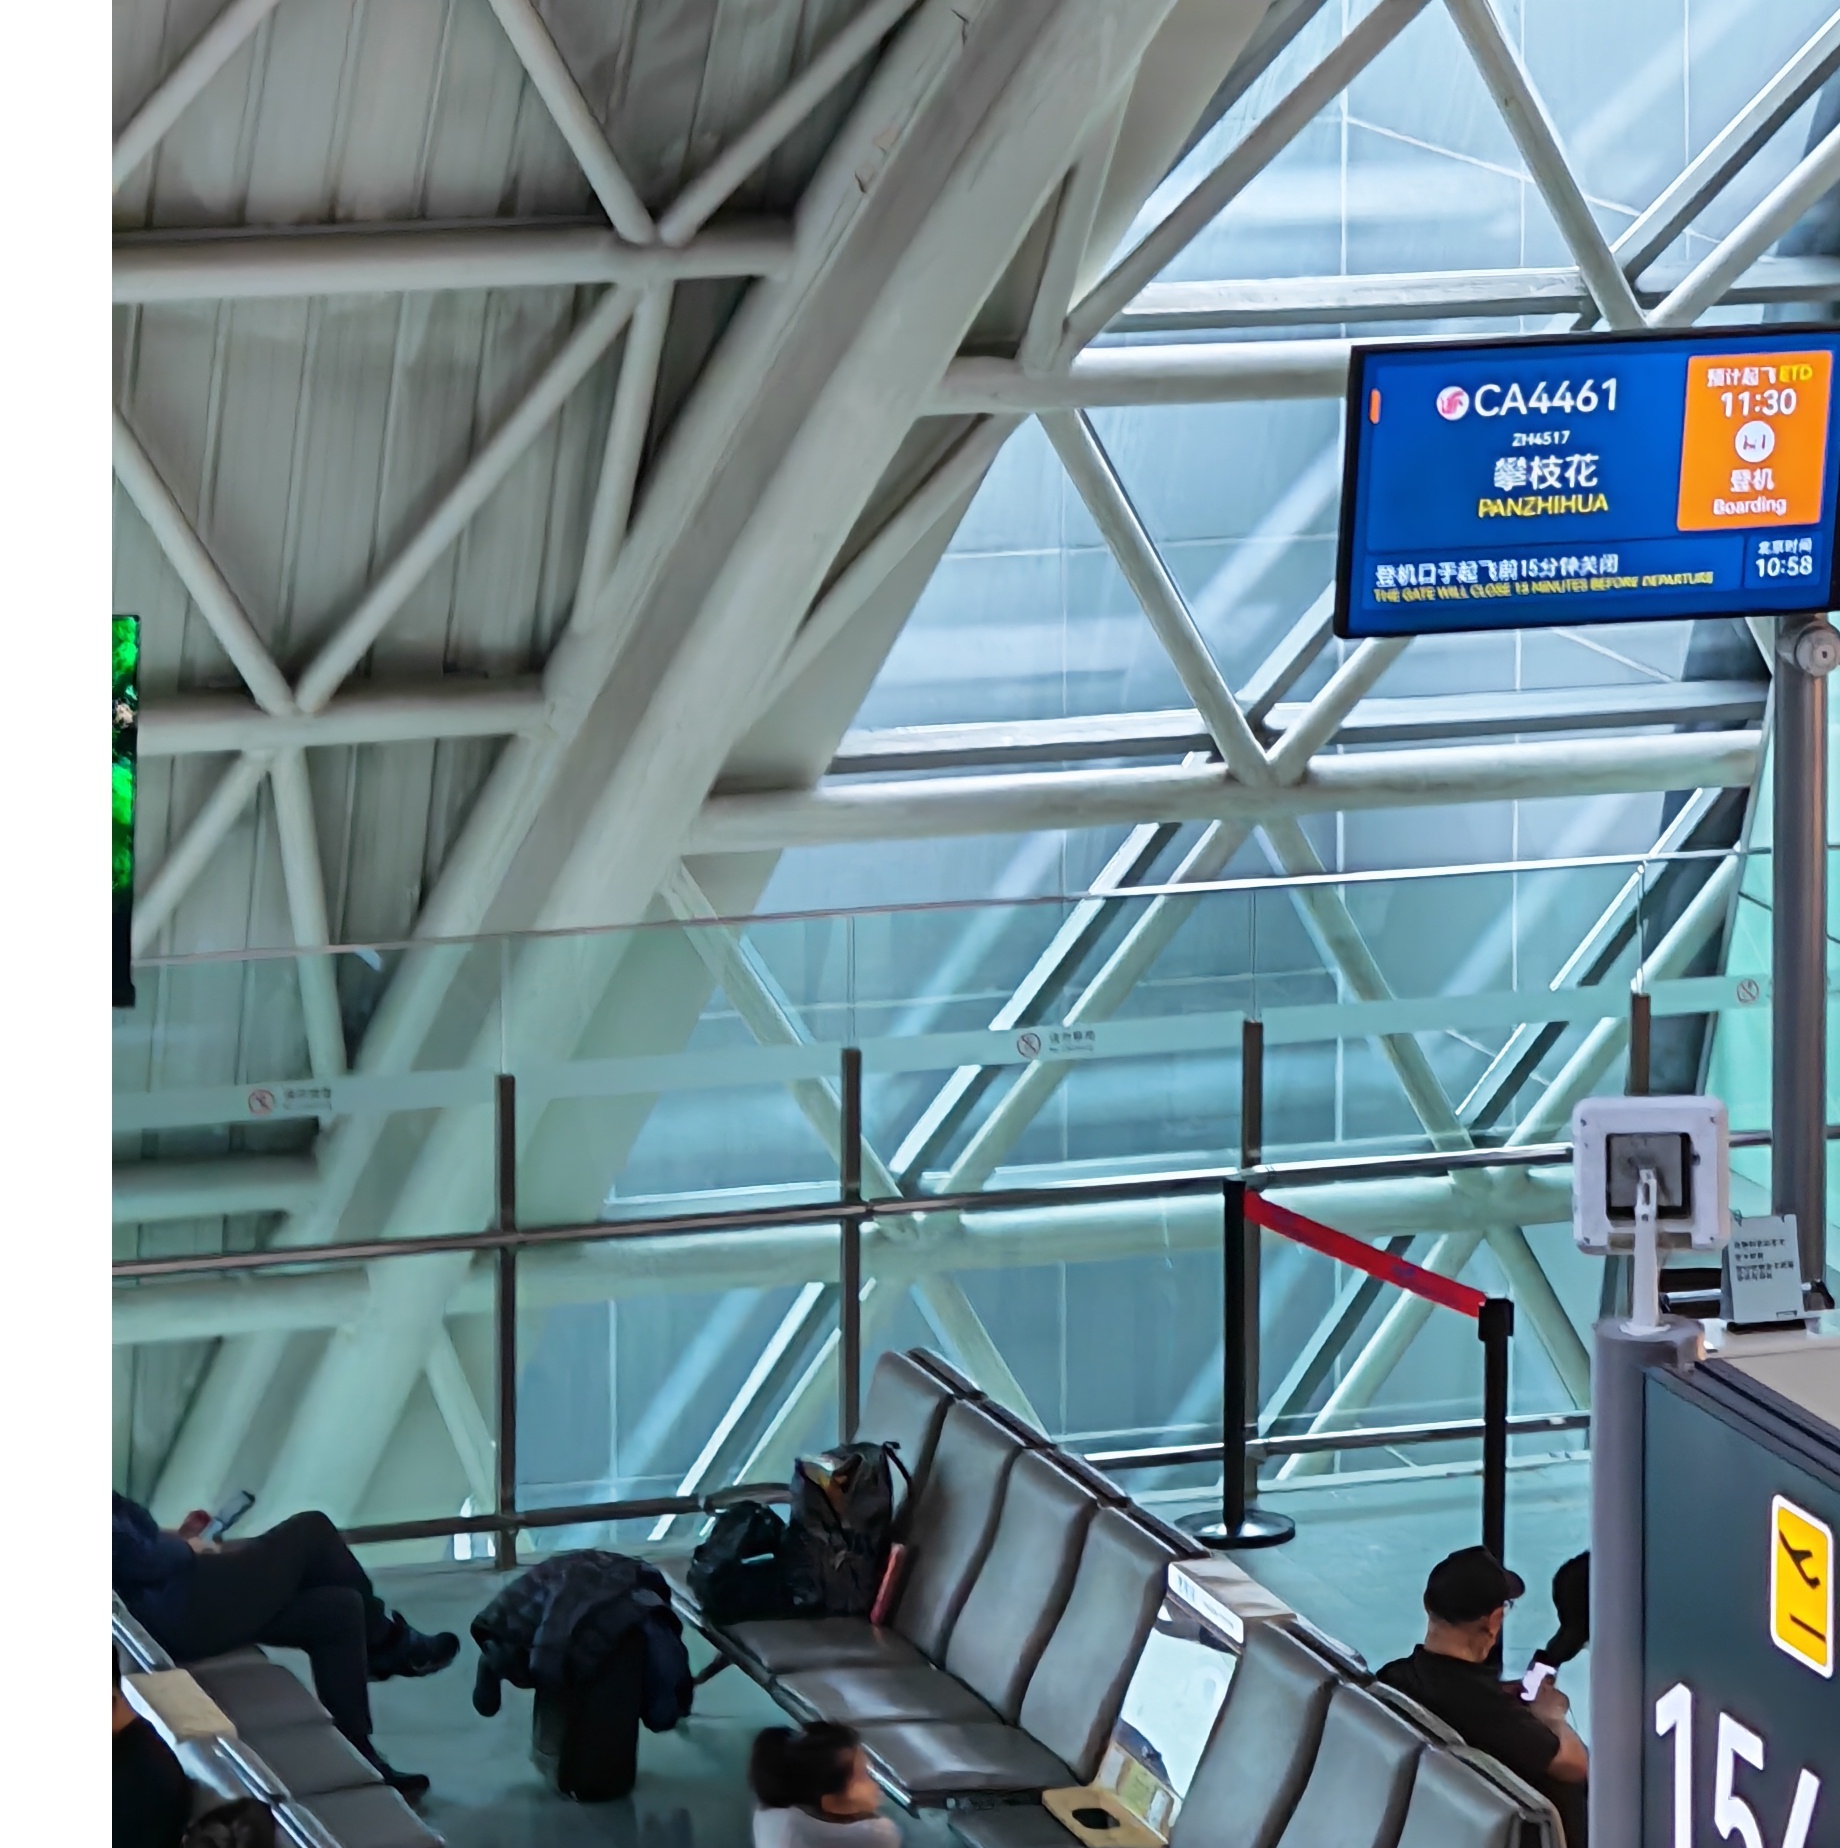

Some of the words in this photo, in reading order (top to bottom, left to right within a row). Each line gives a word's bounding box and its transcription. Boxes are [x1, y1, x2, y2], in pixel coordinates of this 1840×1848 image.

[1474, 377, 1617, 417] CA4461
[1720, 387, 1797, 418] 11:30
[1511, 430, 1571, 447] ZH4517
[1493, 453, 1600, 492] 攀枝花
[1730, 468, 1775, 493] 登机
[1477, 493, 1610, 519] PANZHIHUA
[1712, 496, 1787, 516] Boarding
[1755, 554, 1813, 578] 10:58
